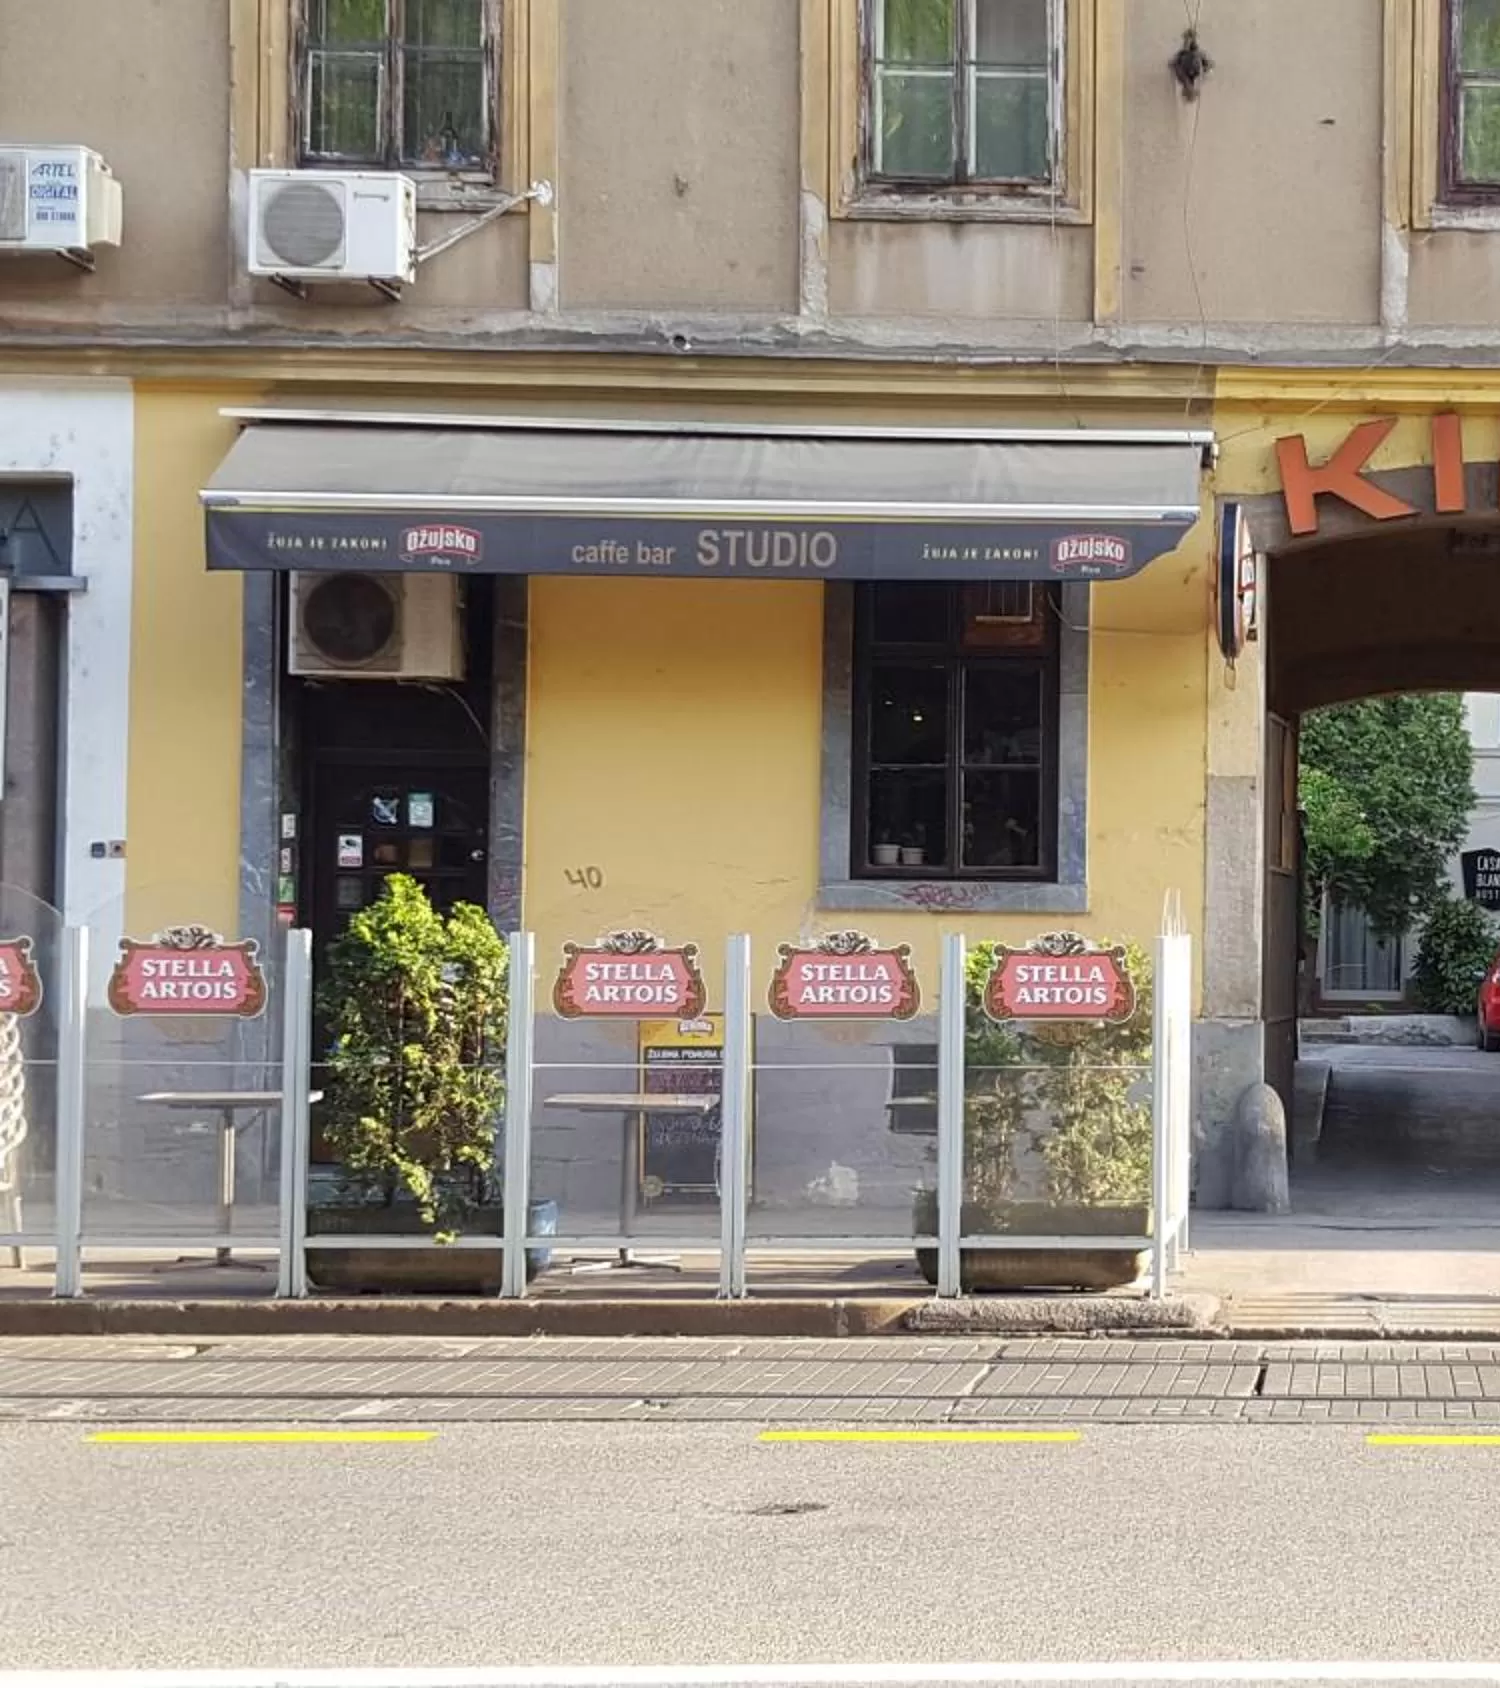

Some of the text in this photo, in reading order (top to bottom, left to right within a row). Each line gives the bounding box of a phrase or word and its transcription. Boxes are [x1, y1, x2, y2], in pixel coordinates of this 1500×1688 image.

[267, 532, 303, 549] ŽUJA
[571, 529, 838, 568] caffe bar STUDIO
[922, 543, 1039, 560] ŽUJA JE ZAKON!
[564, 865, 603, 891] 40
[142, 959, 235, 977] STELLA
[584, 963, 676, 981] STELLA
[800, 964, 891, 982] STELLA
[1015, 965, 1106, 983] STELLA
[140, 980, 238, 1000] ARTOIS
[584, 984, 678, 1003] ARTOIS
[800, 985, 893, 1003] ARTOIS
[1015, 986, 1108, 1005] ARTOIS
